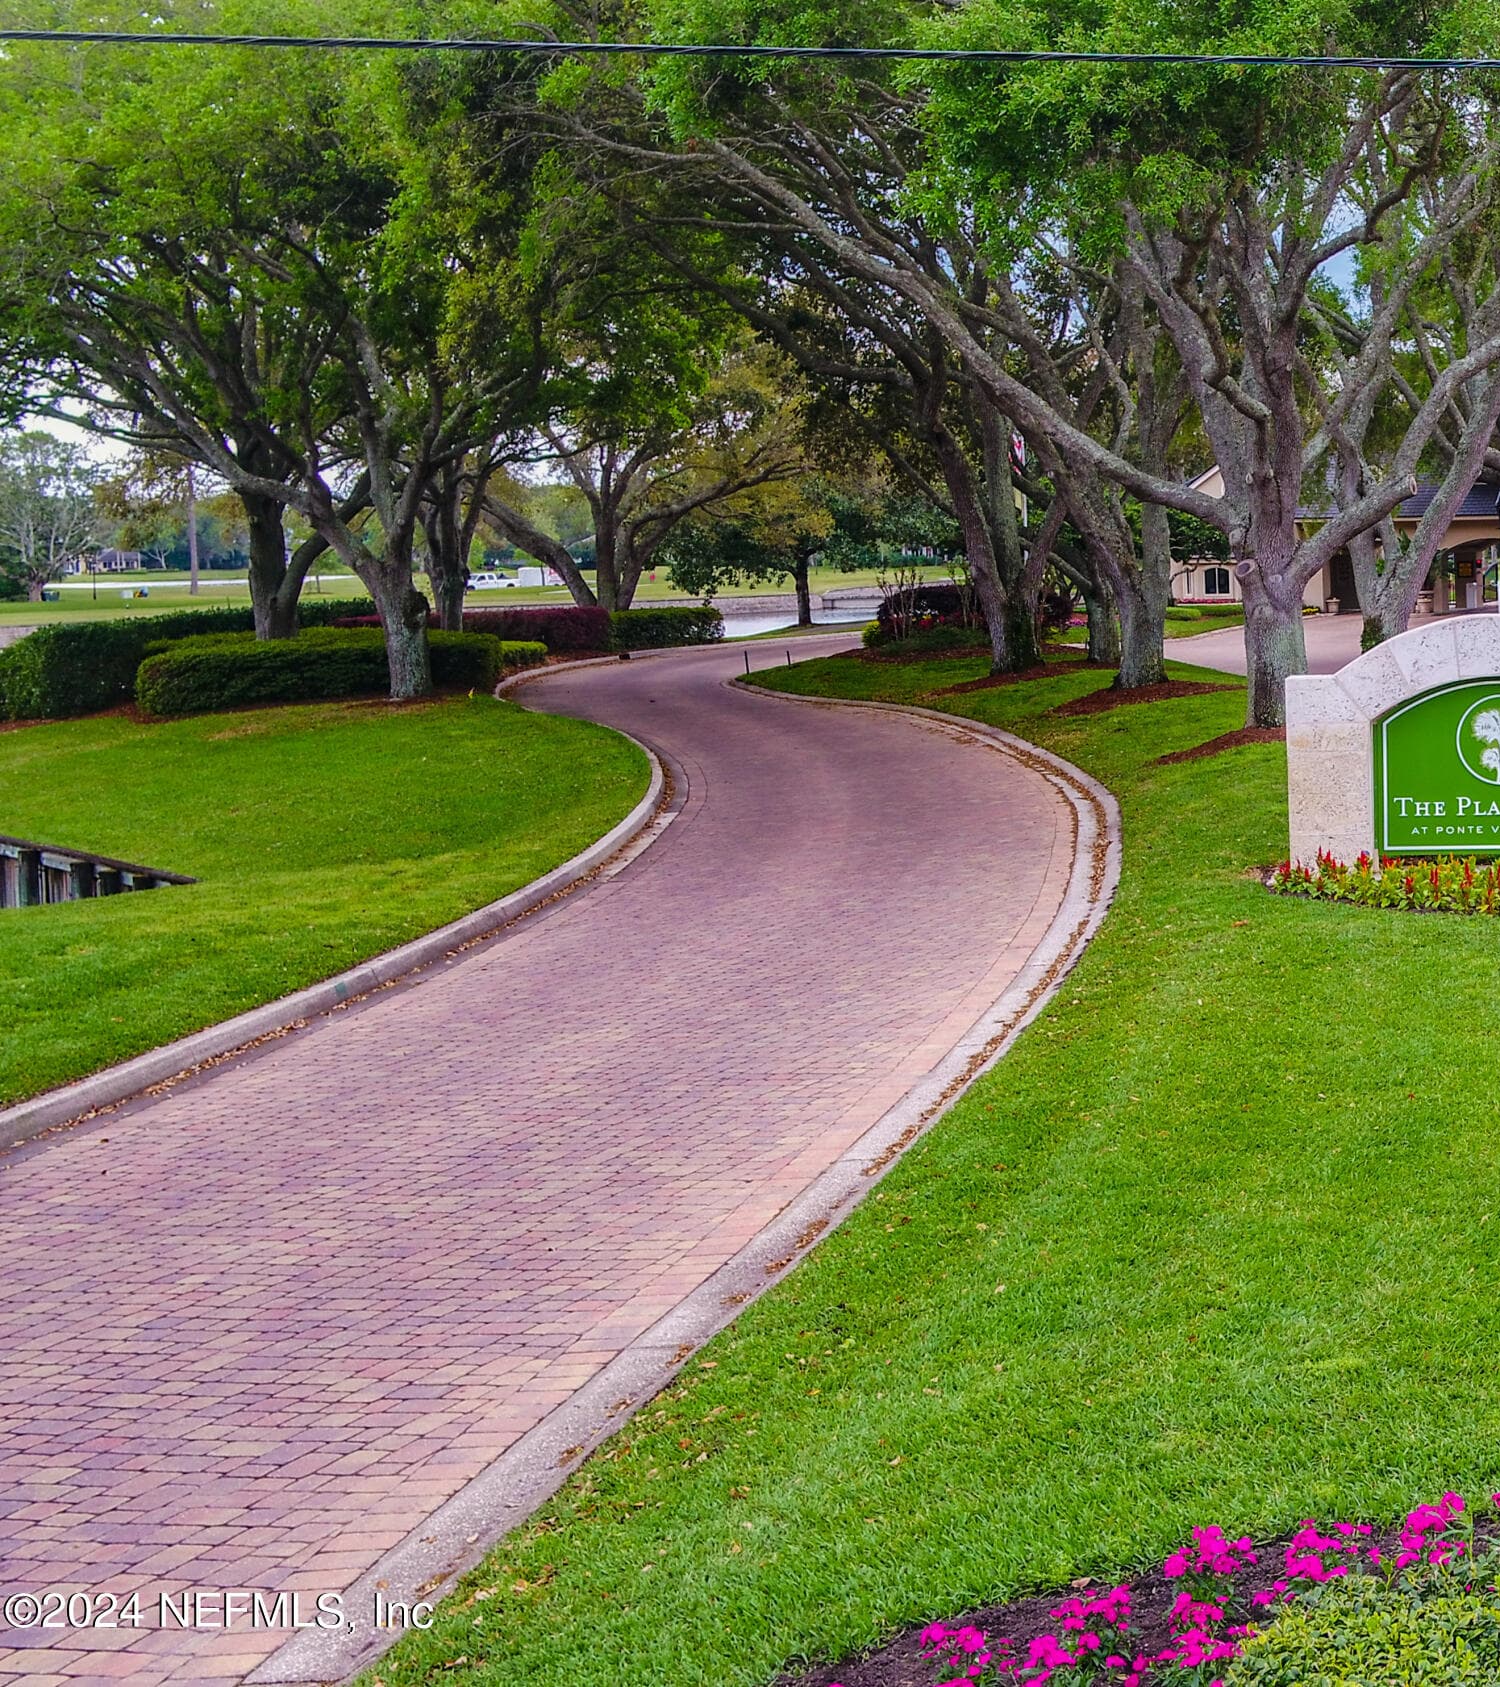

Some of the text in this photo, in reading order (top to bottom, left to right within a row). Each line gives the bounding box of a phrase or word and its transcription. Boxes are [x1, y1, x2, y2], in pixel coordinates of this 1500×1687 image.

[1393, 797, 1446, 817] THE
[1411, 826, 1428, 835] AT
[1435, 825, 1483, 835] PONTE
